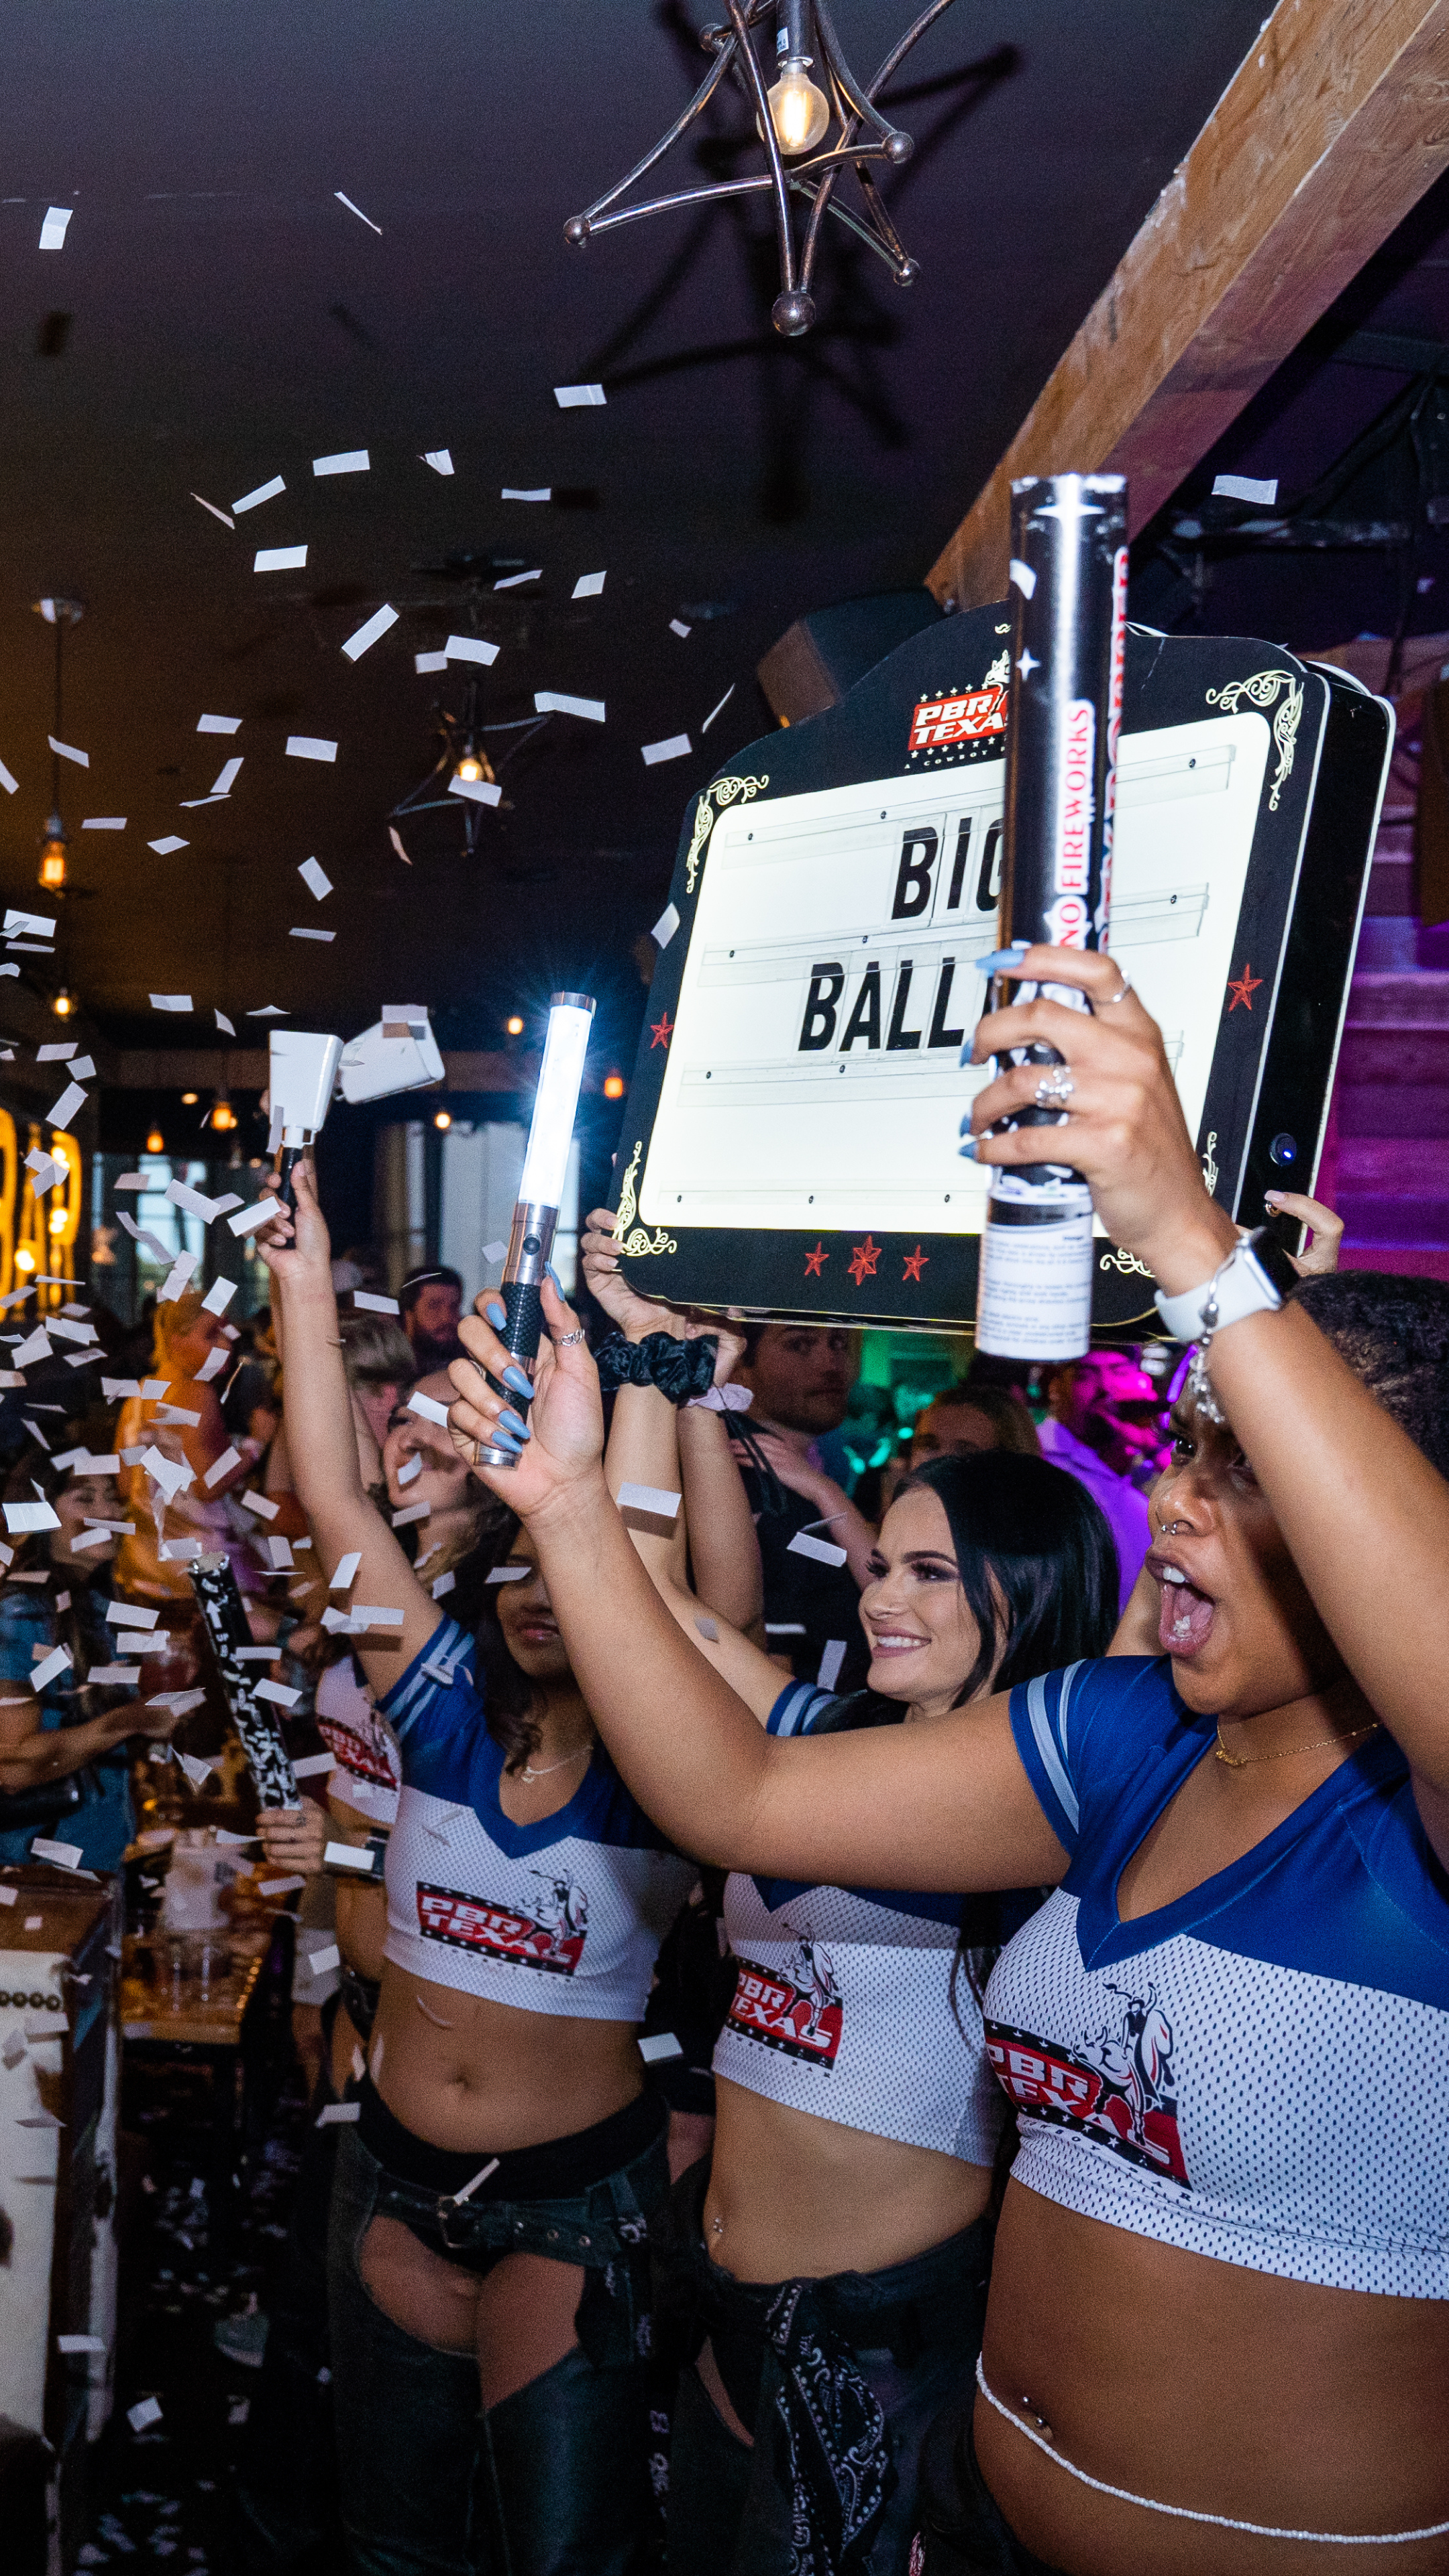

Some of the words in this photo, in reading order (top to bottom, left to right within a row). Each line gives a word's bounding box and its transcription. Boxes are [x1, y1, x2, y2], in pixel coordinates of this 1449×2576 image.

[914, 712, 1008, 745] TEXA
[916, 694, 993, 727] PBR
[923, 749, 988, 766] COWBOY
[1061, 709, 1088, 888] FIREWORKS
[1059, 904, 1081, 947] NO
[798, 957, 988, 1052] BALL
[421, 1895, 522, 1935] PBR
[421, 1912, 572, 1964] TEXAS
[986, 2043, 1088, 2101] PBR
